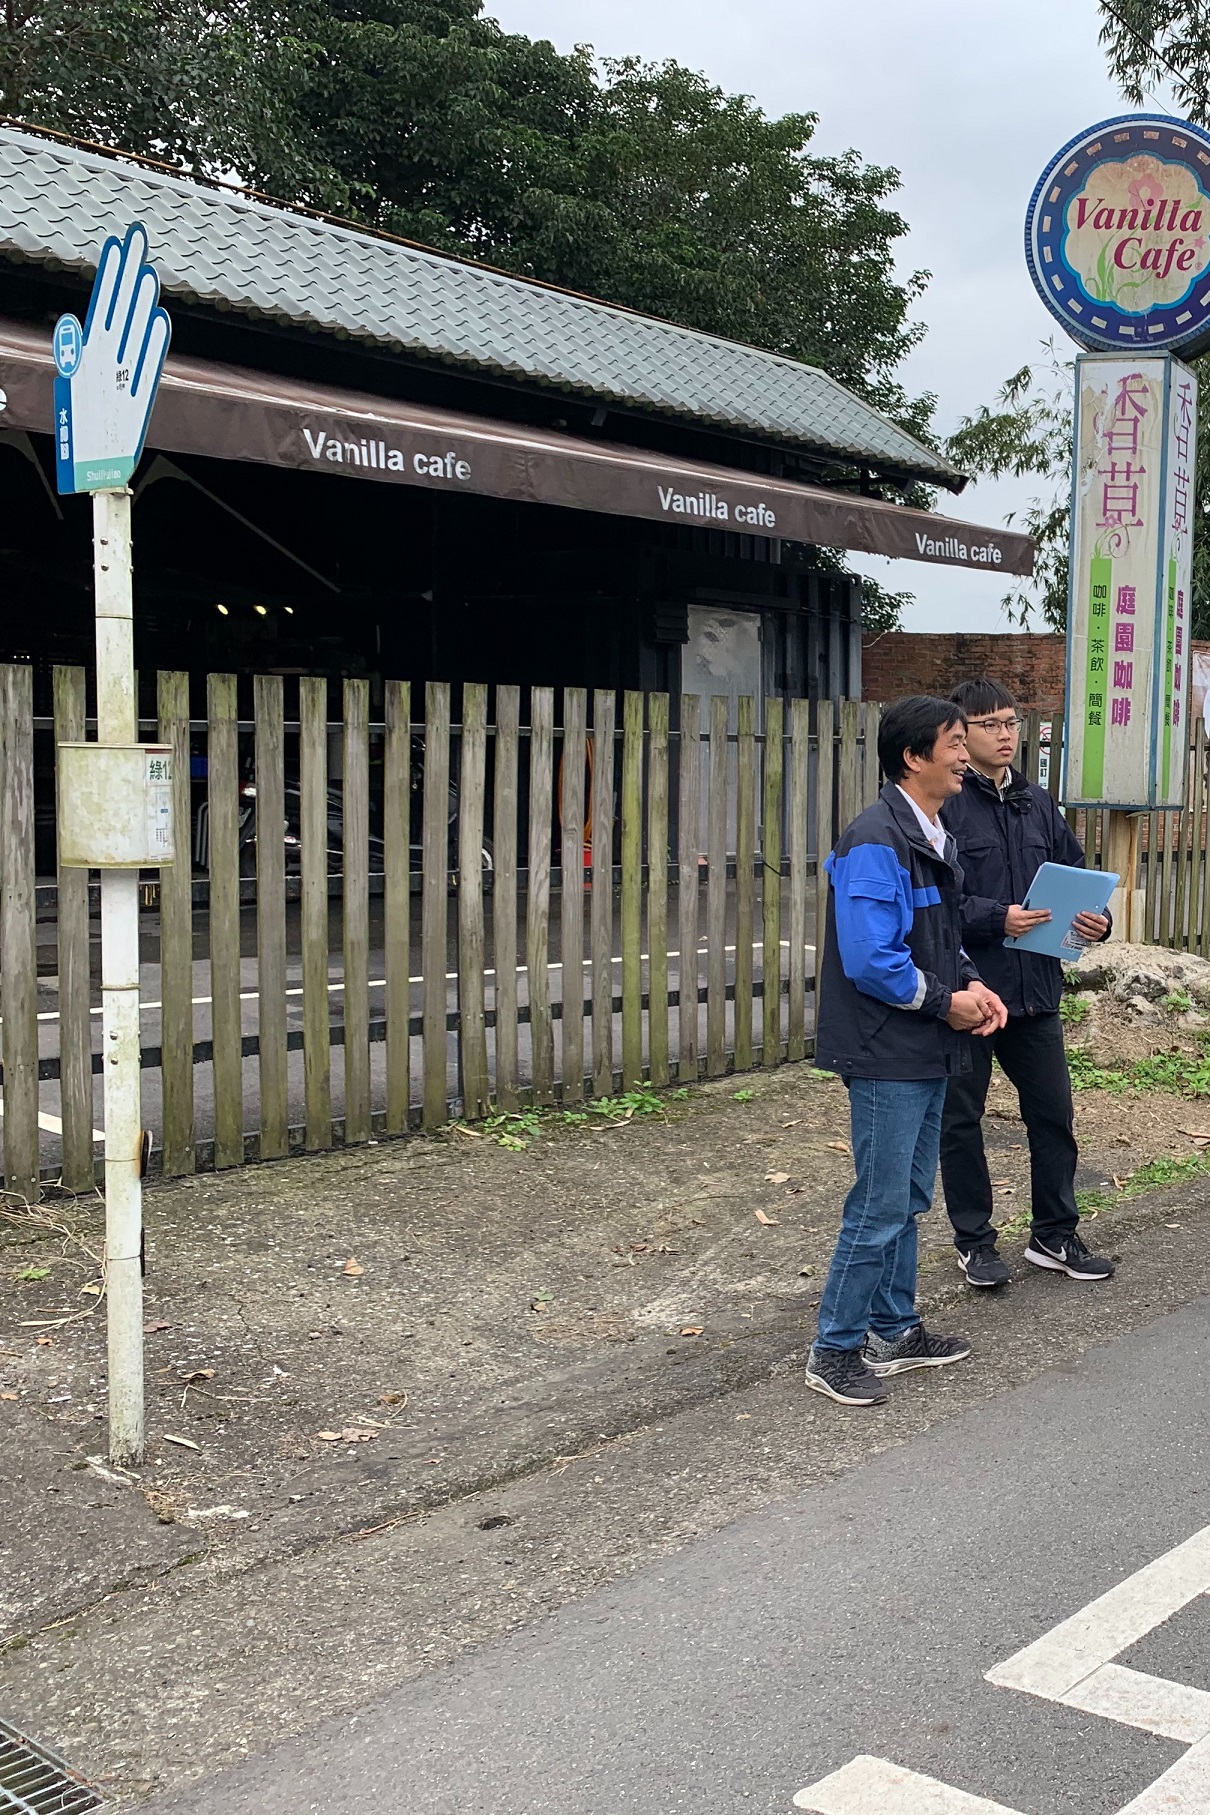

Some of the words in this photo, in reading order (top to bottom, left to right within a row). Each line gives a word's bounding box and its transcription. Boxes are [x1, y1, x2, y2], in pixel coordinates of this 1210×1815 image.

[1076, 197, 1203, 232] Vanilla
[1113, 237, 1196, 279] Cafe
[302, 428, 405, 472] Vanilla
[413, 451, 472, 480] cafe
[657, 485, 729, 520] Vanilla
[734, 503, 776, 528] cafe
[915, 532, 968, 560] Vanilla
[970, 543, 1002, 564] cafe
[1111, 584, 1137, 727] 庭園咖啡
